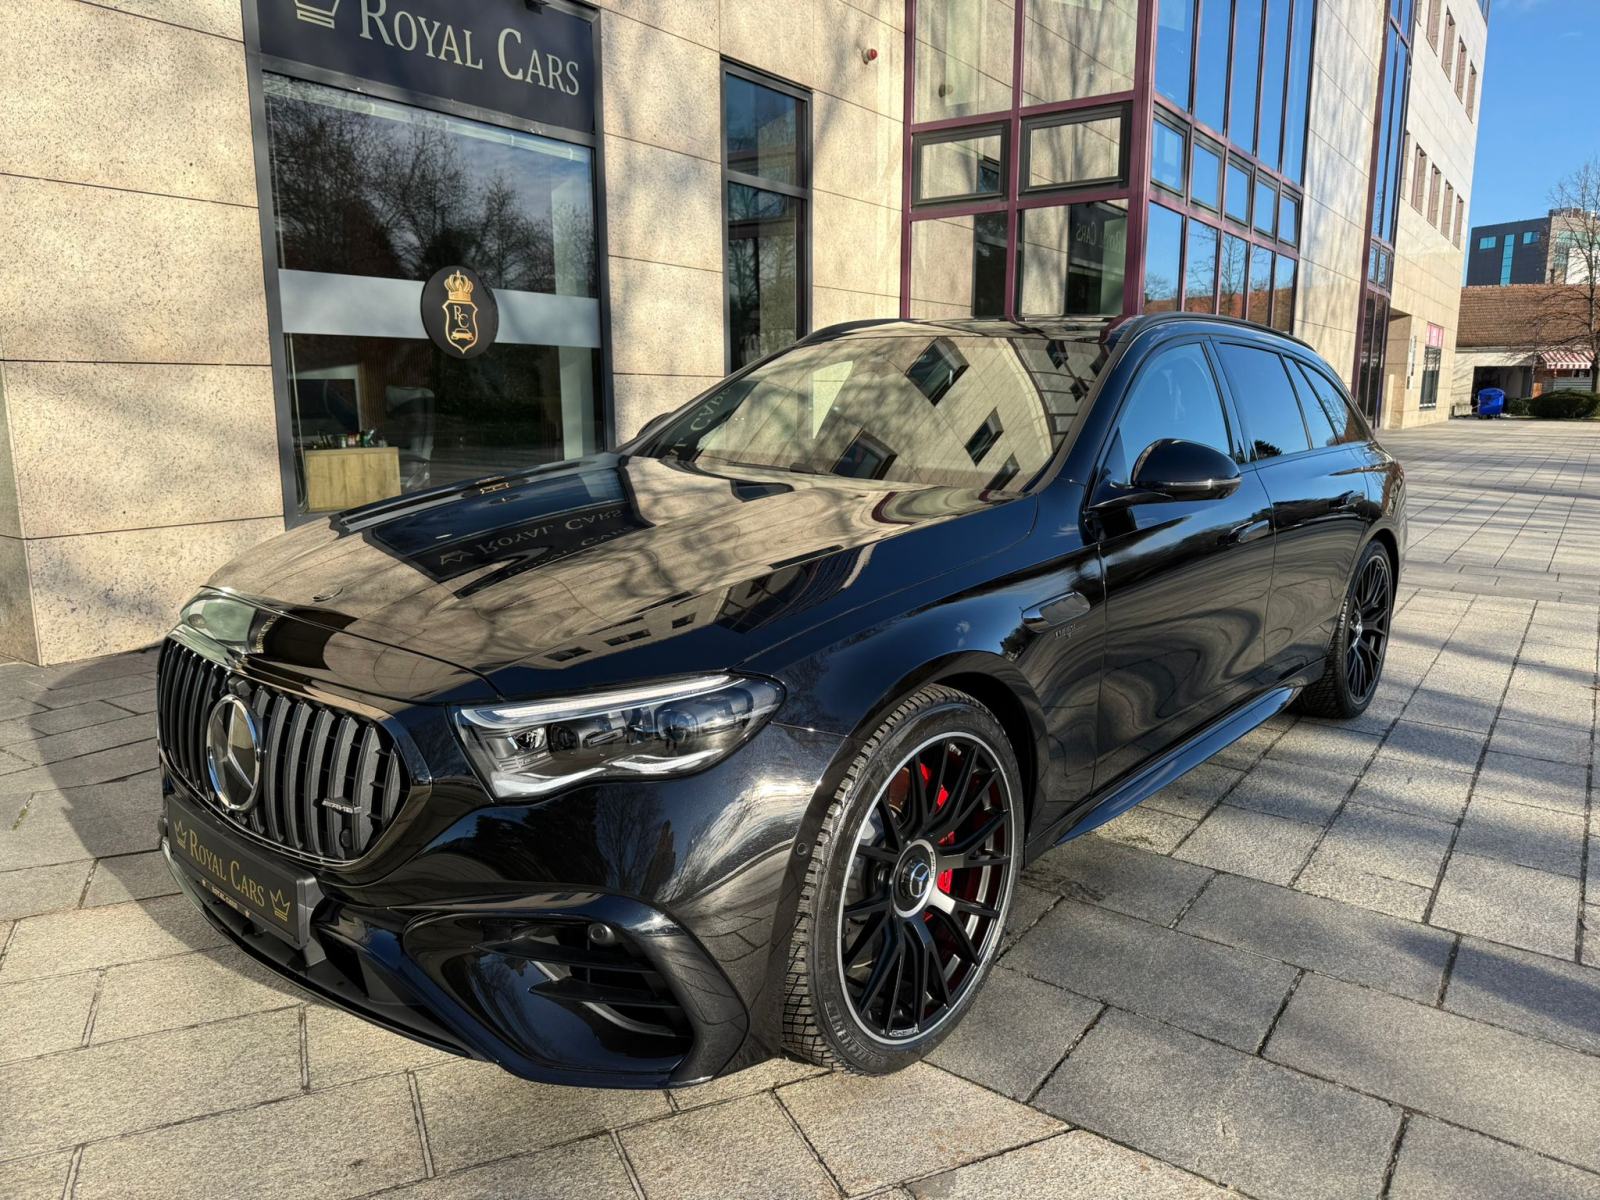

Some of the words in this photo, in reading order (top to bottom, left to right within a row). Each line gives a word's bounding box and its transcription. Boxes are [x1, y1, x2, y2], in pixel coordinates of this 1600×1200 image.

[360, 0, 483, 70] ROYAL
[498, 28, 580, 96] CARS
[189, 829, 227, 881] ROYAL
[230, 860, 265, 907] CARS
